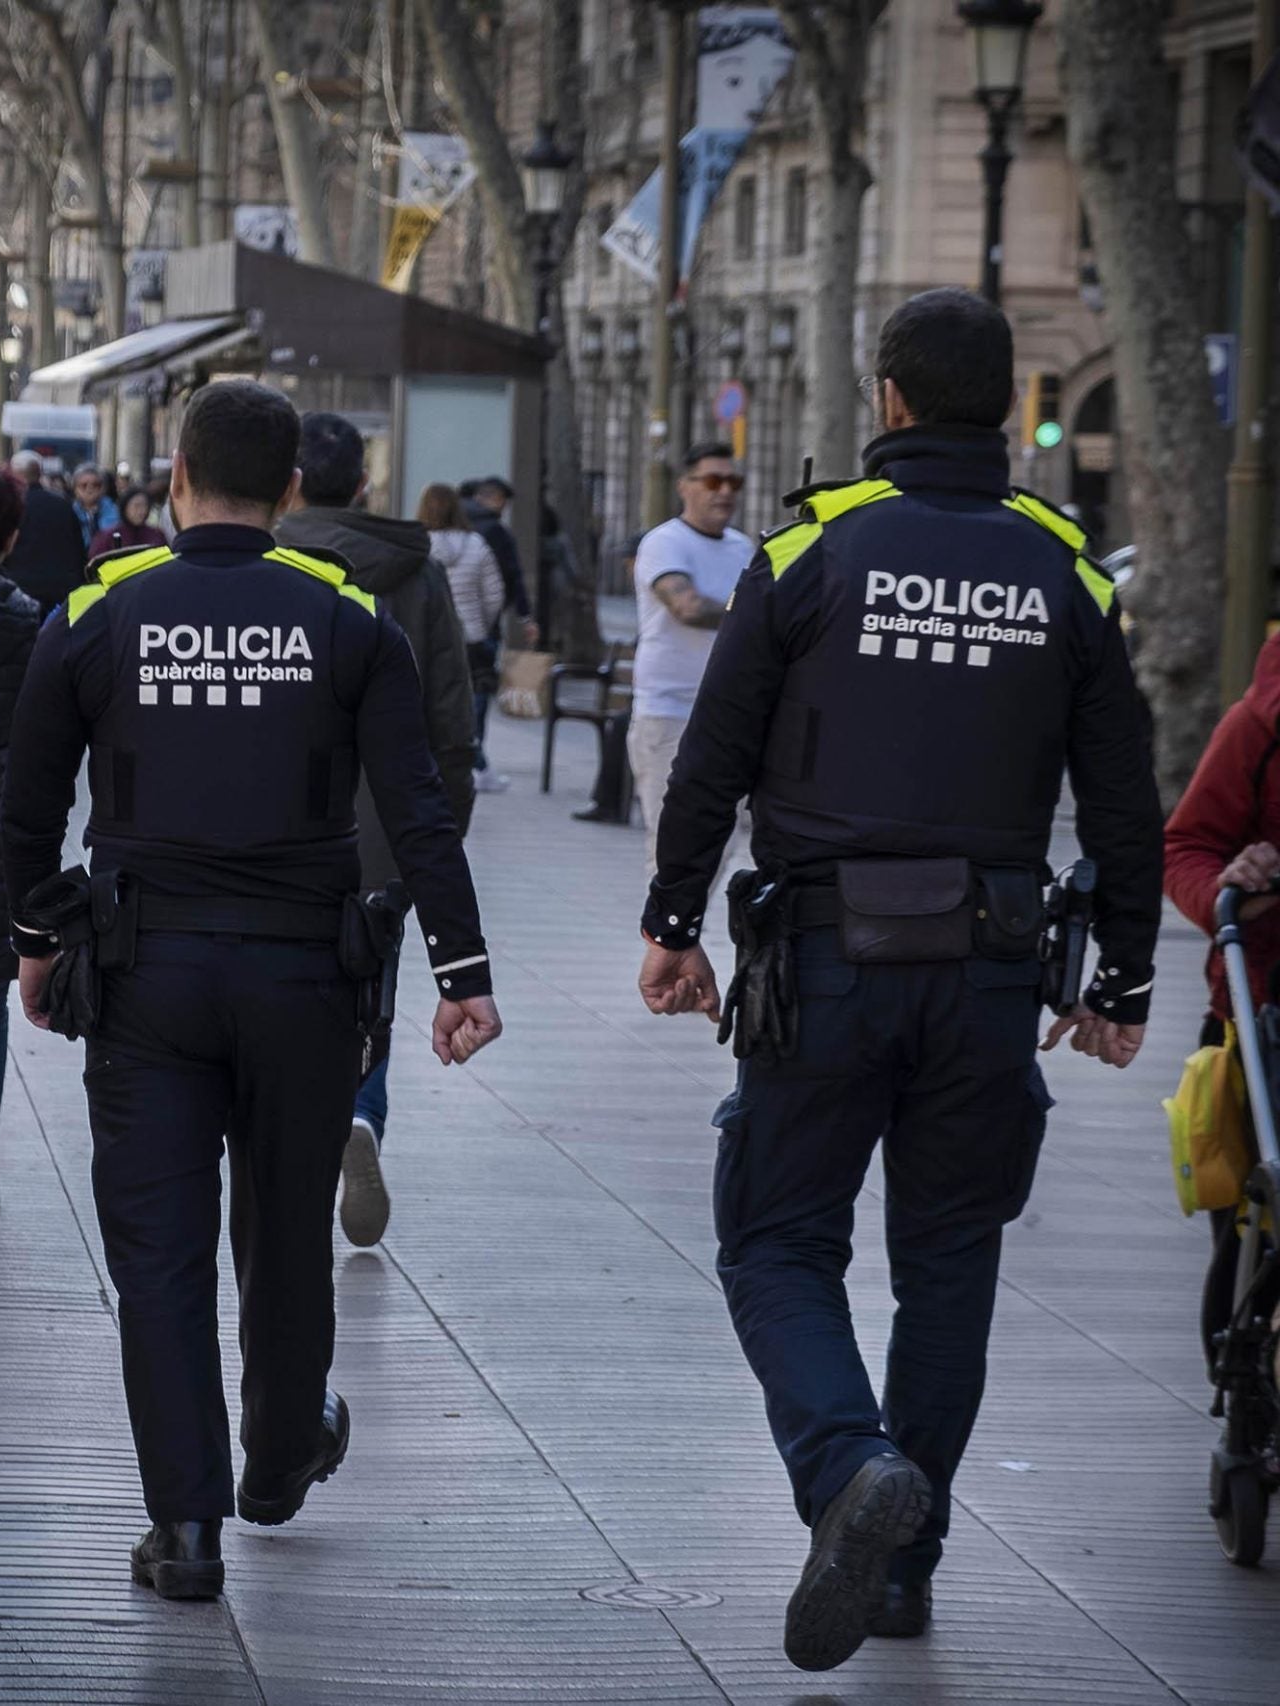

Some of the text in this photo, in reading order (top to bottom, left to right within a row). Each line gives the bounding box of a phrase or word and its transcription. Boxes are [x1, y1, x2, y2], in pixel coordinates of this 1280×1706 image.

[864, 570, 1050, 624] POLICIA
[139, 623, 313, 661] POLICIA
[862, 612, 1047, 646] guàrdia urbana
[138, 661, 313, 683] guàrdia urbana
